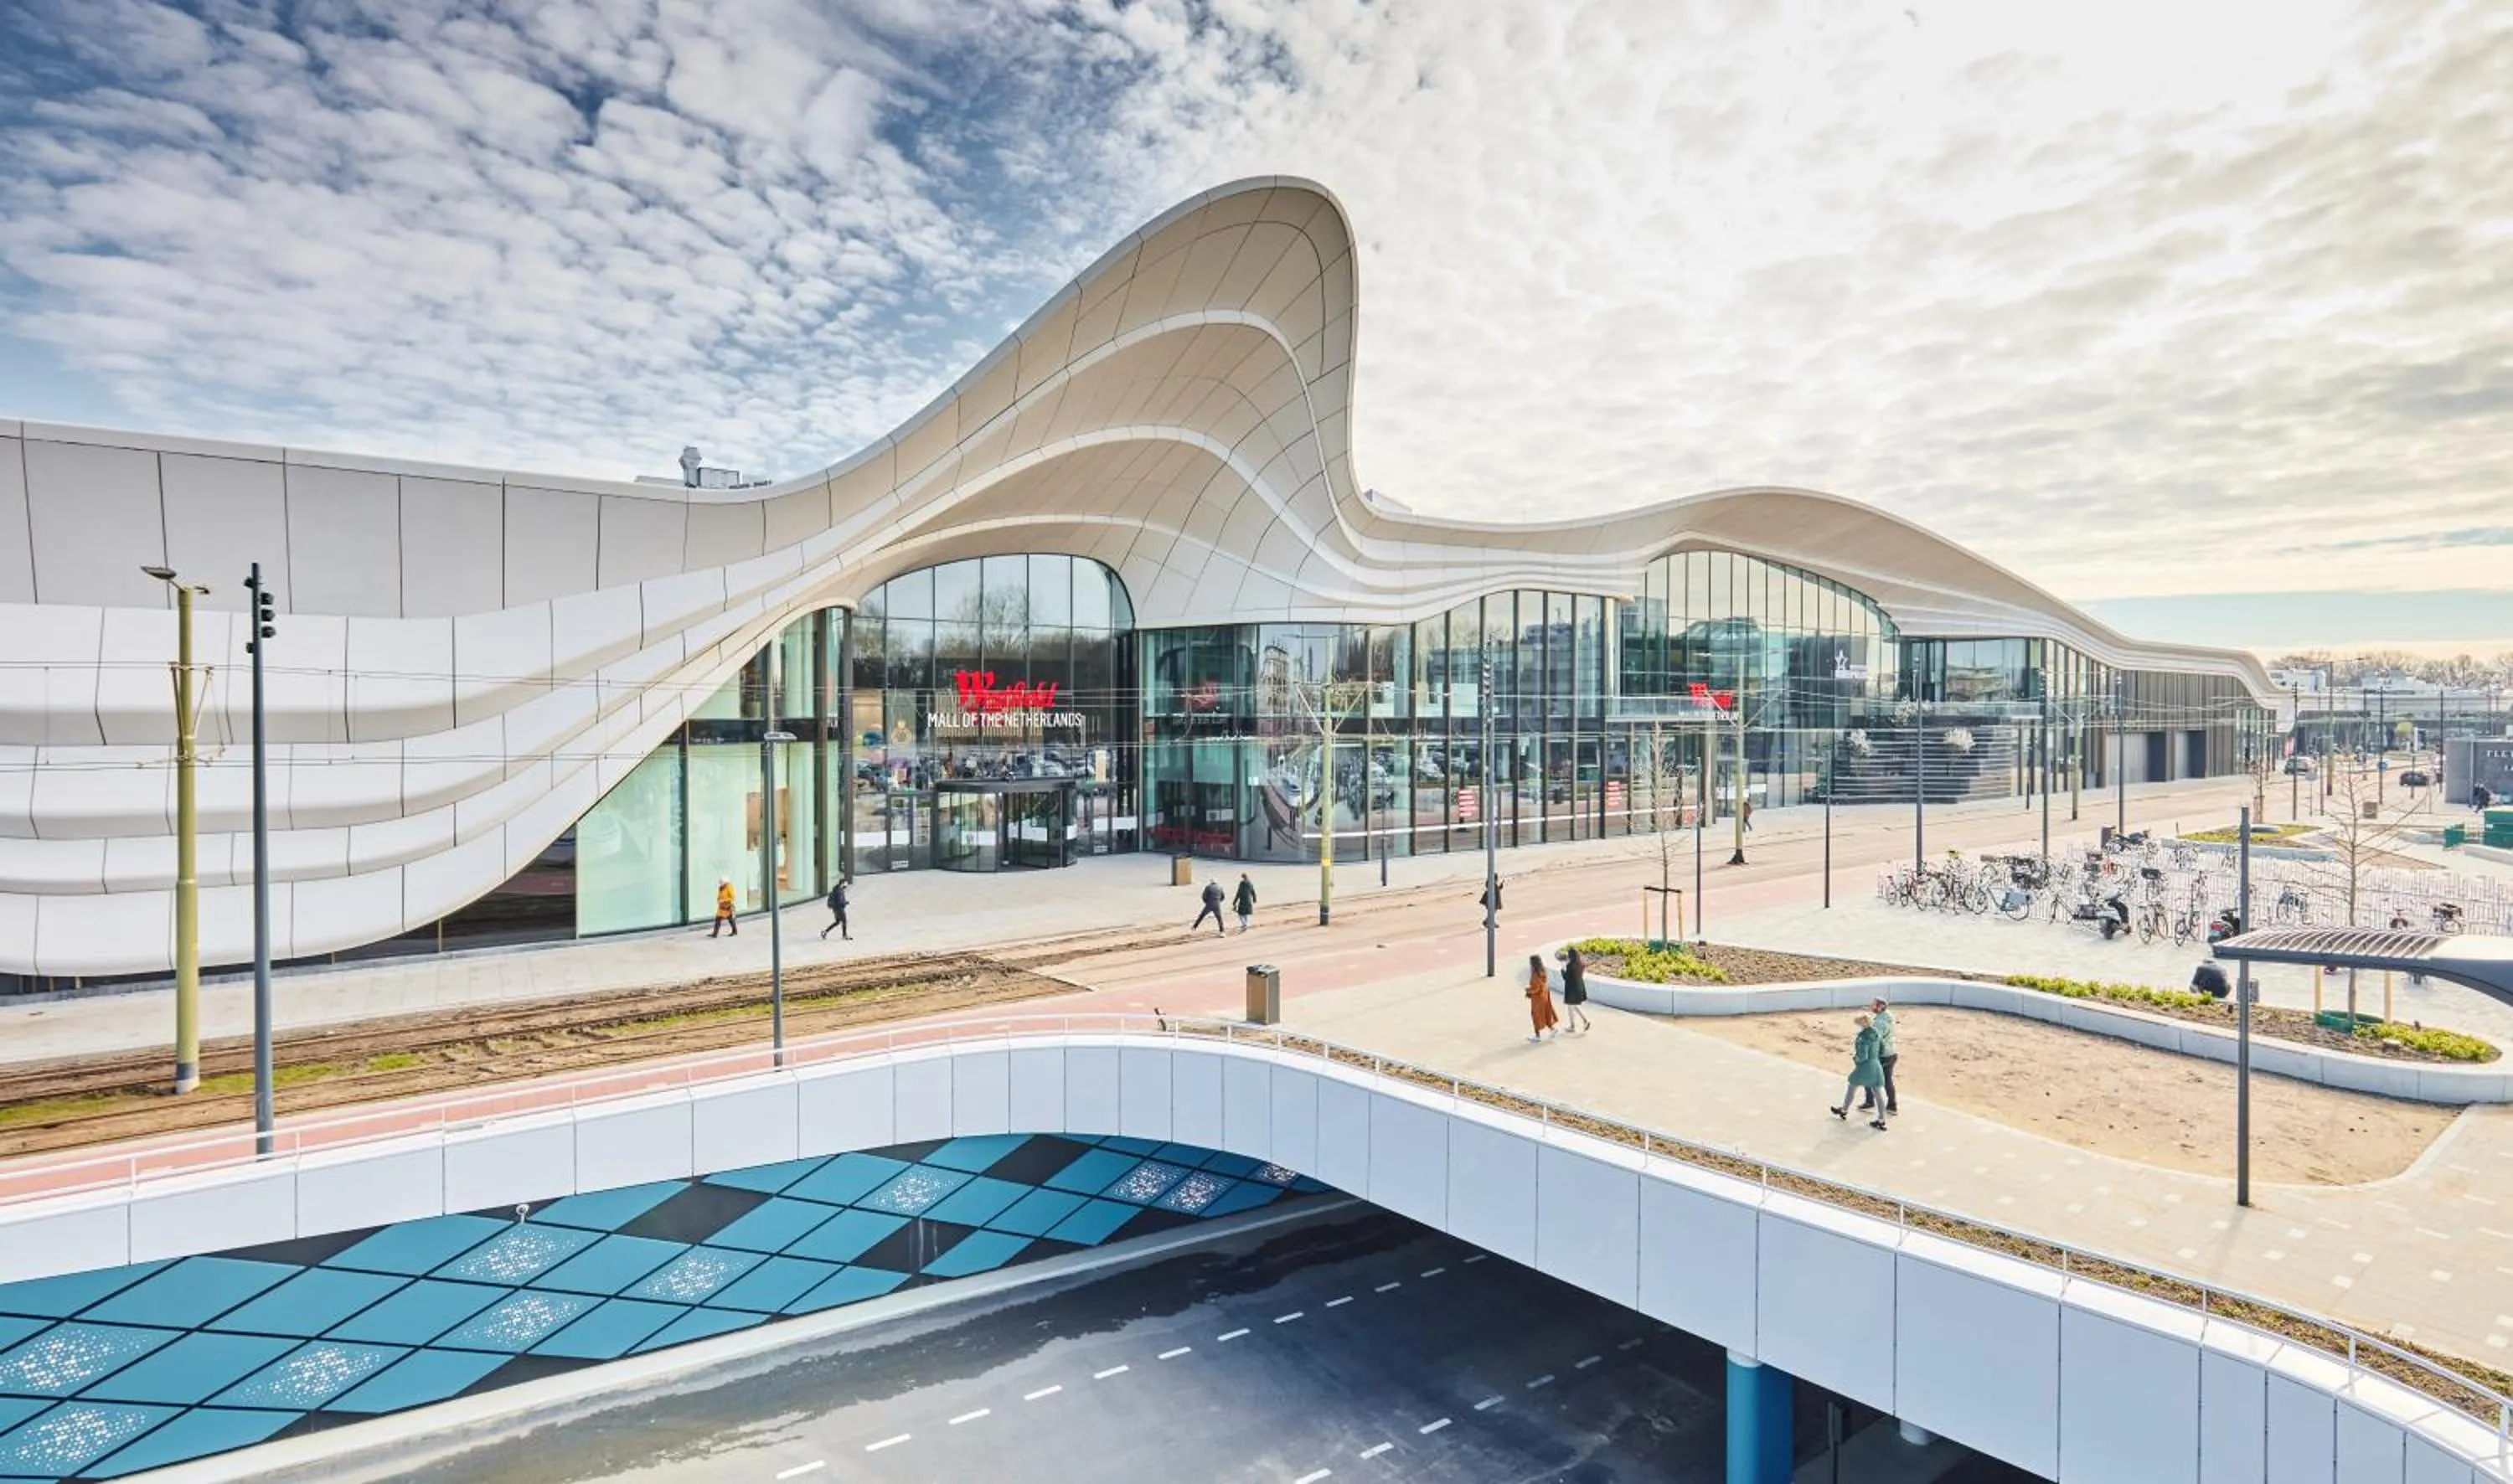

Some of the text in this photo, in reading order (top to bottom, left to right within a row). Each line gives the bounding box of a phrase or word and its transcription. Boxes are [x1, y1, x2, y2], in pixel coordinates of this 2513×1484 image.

[953, 671, 1059, 710] Westfield
[927, 713, 1082, 728] MALL OF THE NETHERLANDS
